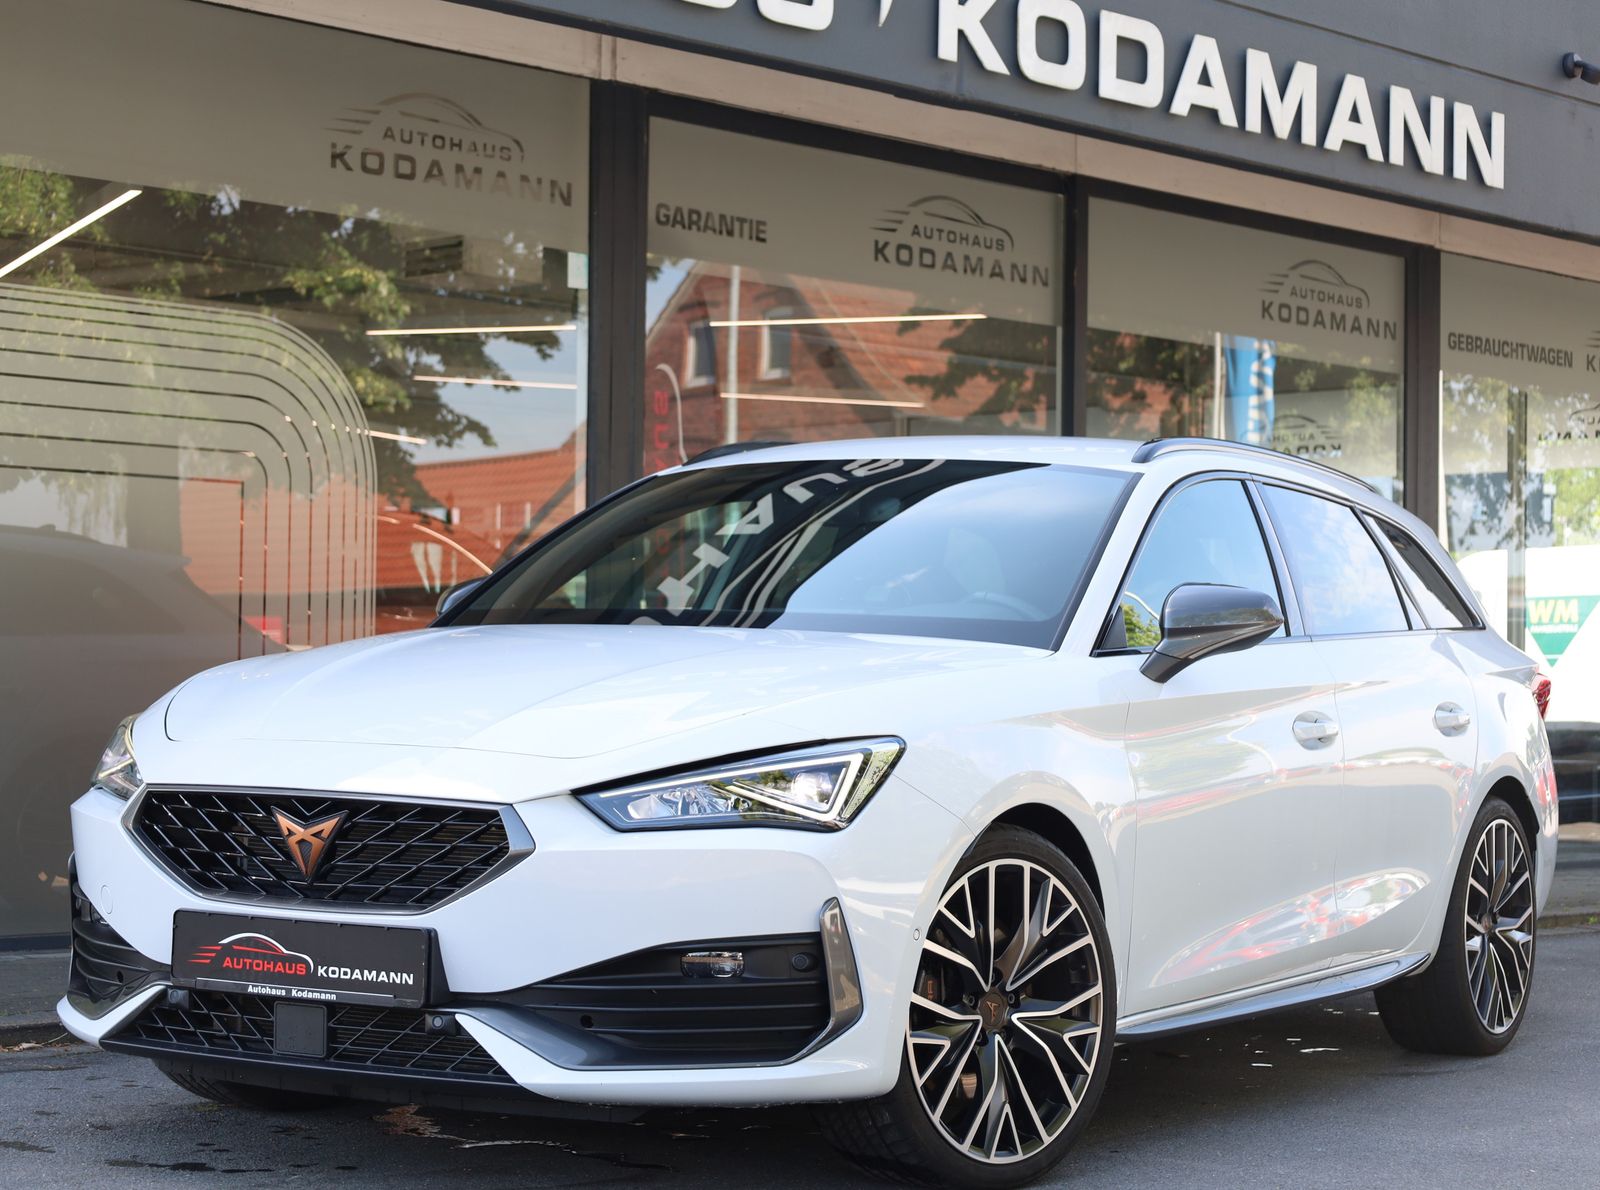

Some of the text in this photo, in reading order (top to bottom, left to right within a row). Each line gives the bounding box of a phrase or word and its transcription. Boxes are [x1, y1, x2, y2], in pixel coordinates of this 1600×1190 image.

[937, 0, 1505, 190] KODAMANN
[384, 126, 513, 162] AUTOHAUS
[330, 142, 573, 208] KODAMANN
[655, 203, 767, 243] GARANTIE
[911, 223, 1006, 252] AUTOHAUS
[873, 239, 1050, 288] KODAMANN
[1290, 287, 1363, 308] AUTOHAUS
[1261, 300, 1397, 340] KODAMANN
[1447, 332, 1573, 368] GEBRAUCHTWAGEN
[1527, 599, 1579, 625] WM
[223, 957, 414, 985] AUTOHAUS KODAMANN
[247, 984, 337, 1001] Autohaus Kodamann
